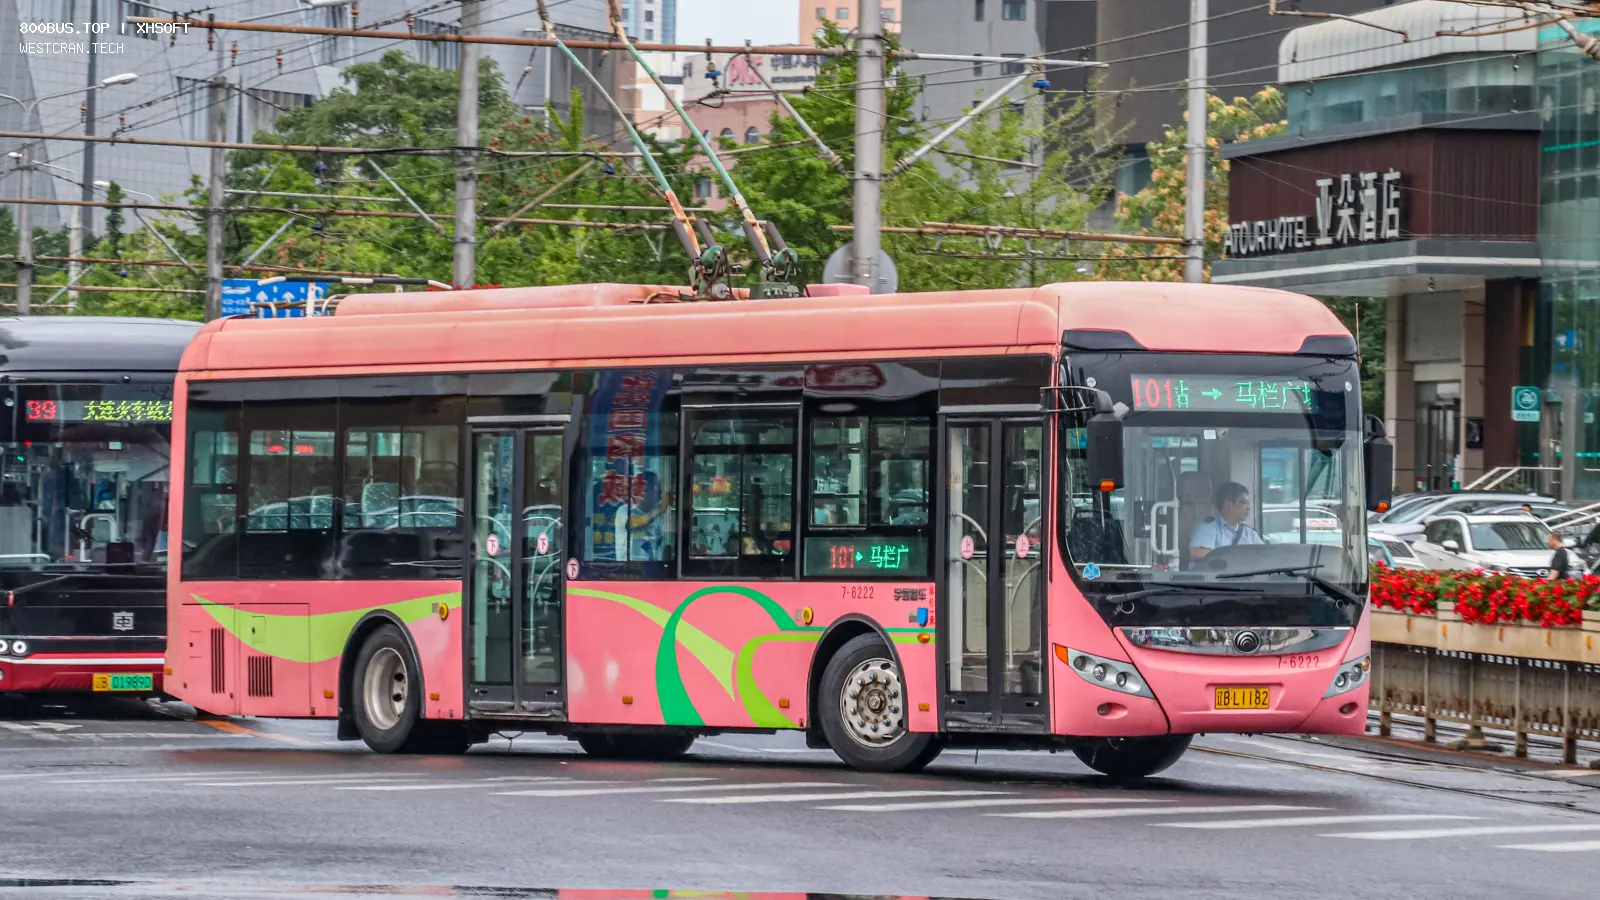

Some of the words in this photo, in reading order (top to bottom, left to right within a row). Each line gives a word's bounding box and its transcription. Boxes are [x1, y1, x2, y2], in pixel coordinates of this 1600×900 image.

[1314, 167, 1401, 246] 亚朵酒店
[1267, 215, 1312, 251] HOTEL
[1132, 378, 1173, 409] 101
[26, 400, 57, 420] 39
[829, 545, 855, 569] 101
[869, 544, 909, 569] 马栏广
[841, 586, 875, 600] 7-6222
[1276, 655, 1320, 669] 7-6222
